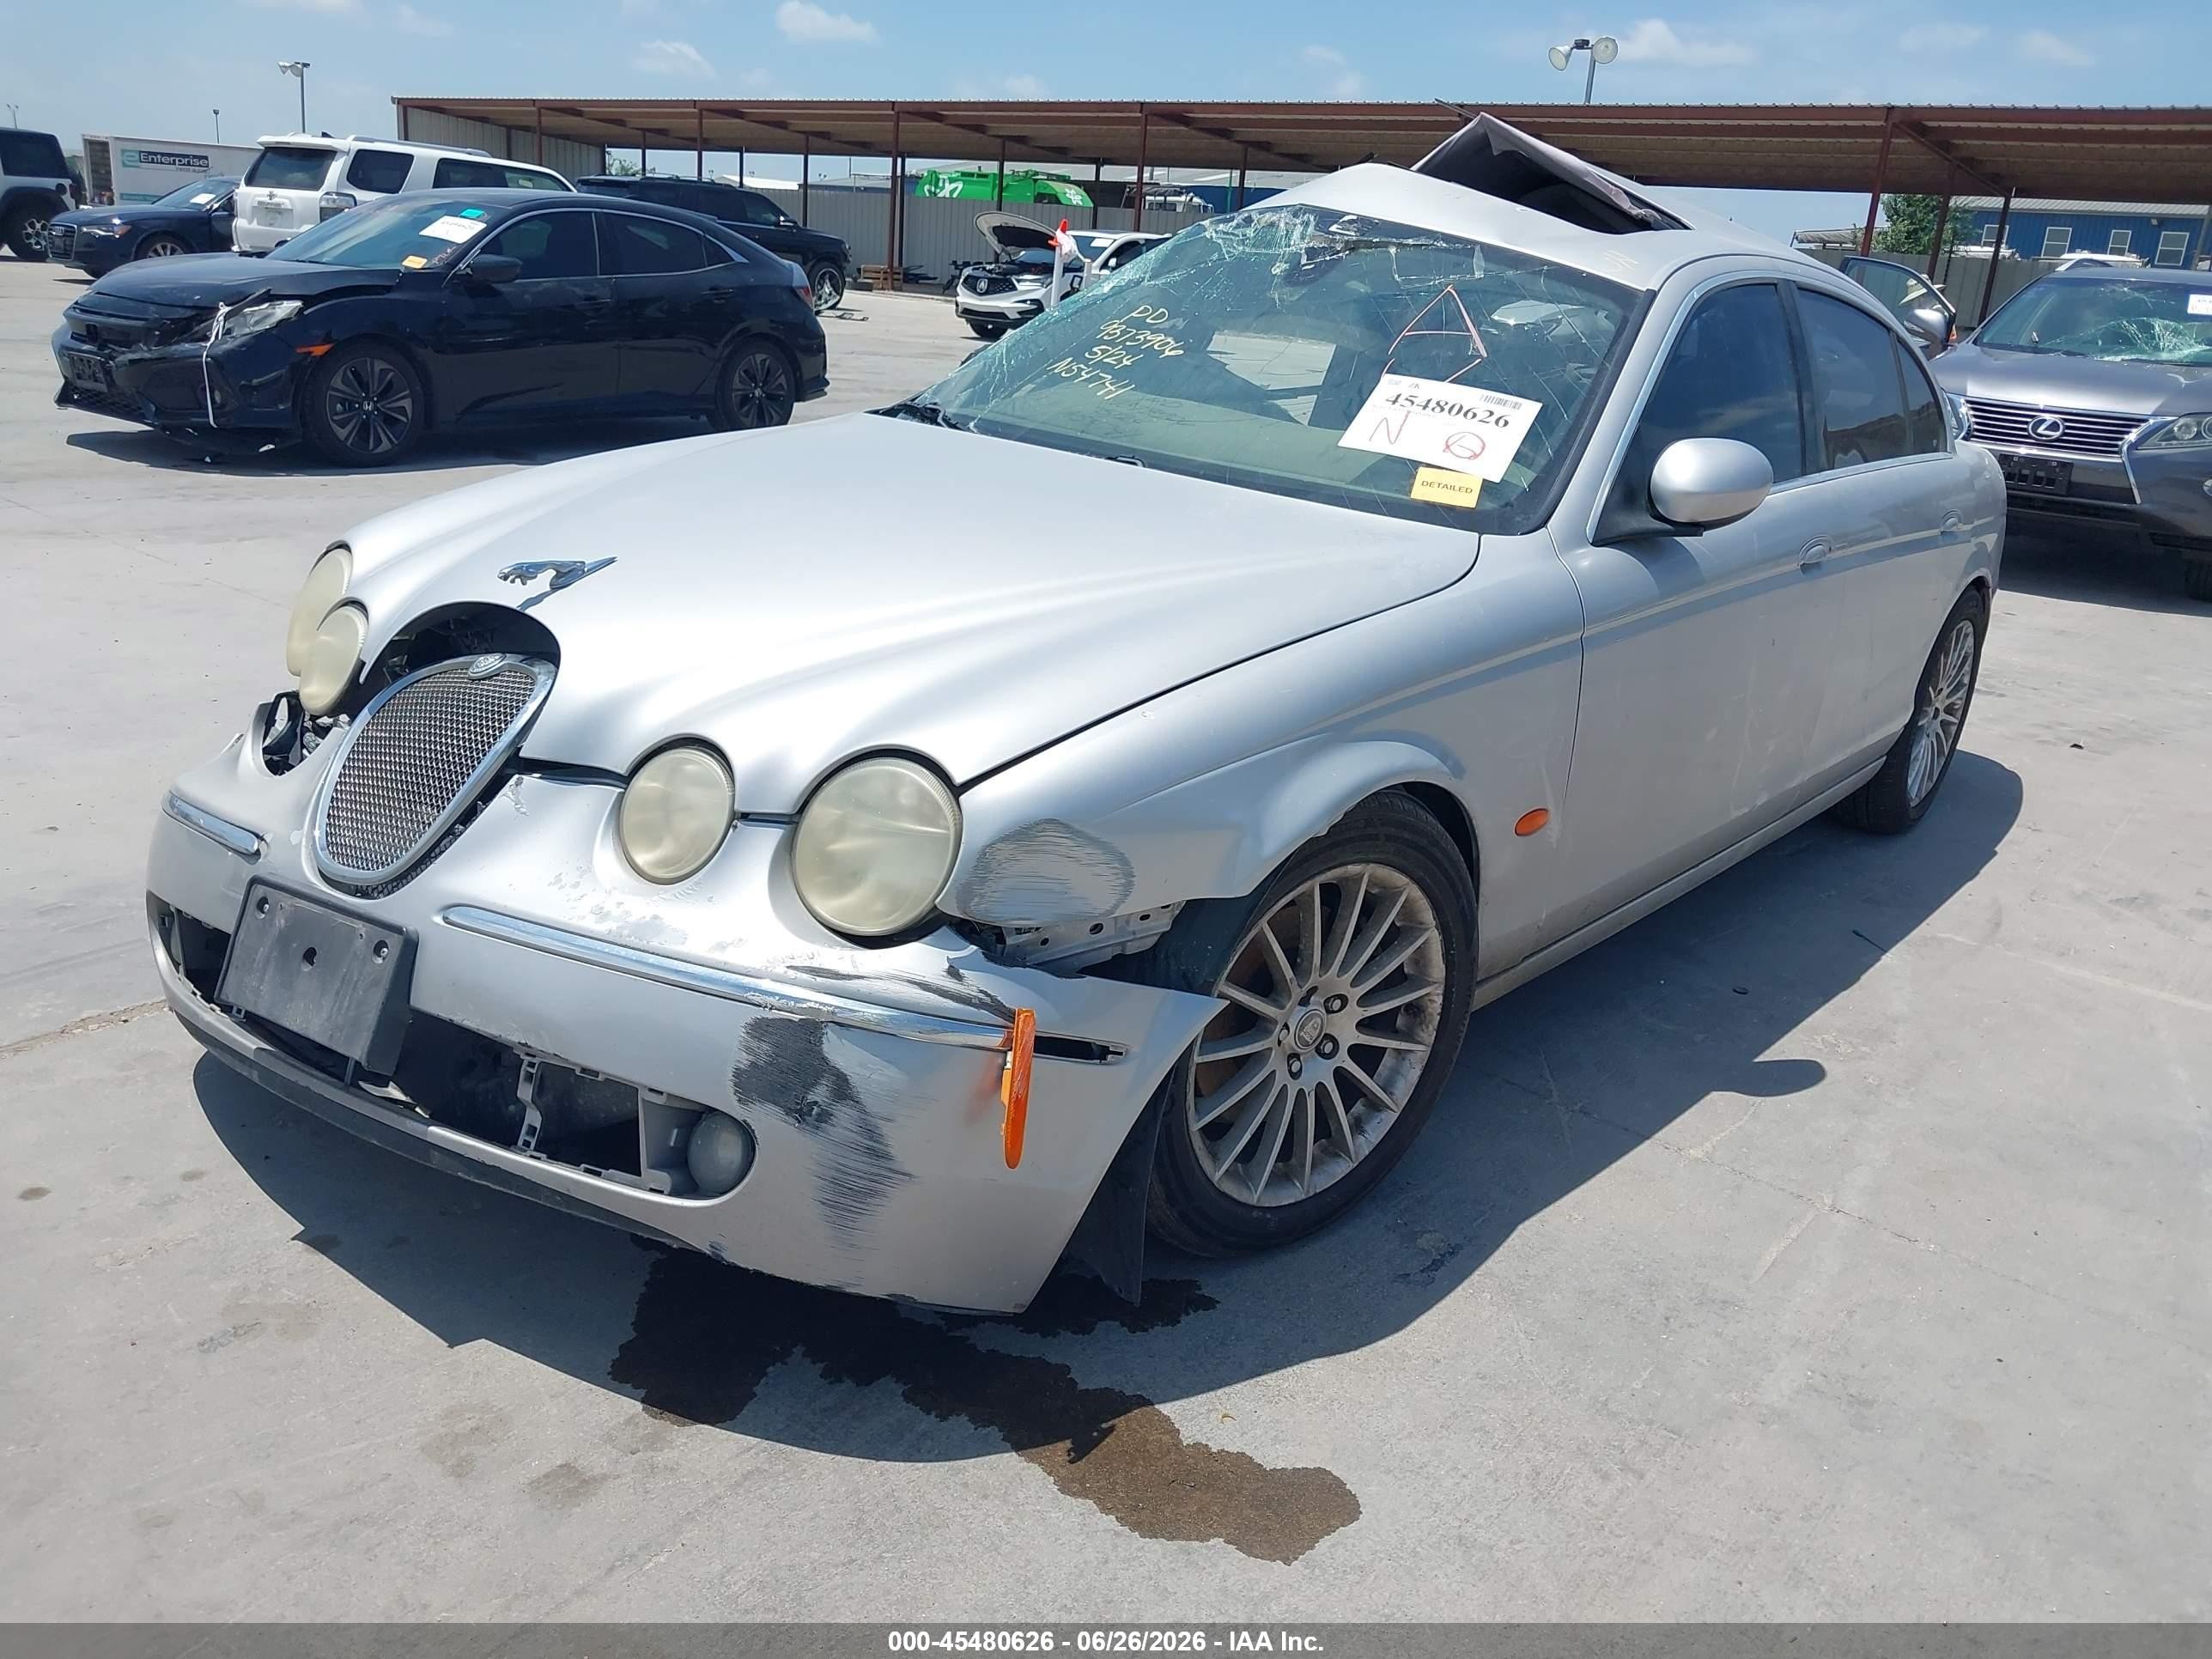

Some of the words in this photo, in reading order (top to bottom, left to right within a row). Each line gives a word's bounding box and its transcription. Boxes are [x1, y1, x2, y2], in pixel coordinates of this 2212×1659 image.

[140, 152, 209, 167] Enterprise
[1121, 305, 1168, 324] PD
[1085, 345, 1144, 369] 5/24
[1046, 357, 1136, 400] N54741
[1384, 392, 1510, 428] 45480626
[1369, 410, 1411, 445] N
[1420, 479, 1474, 495] DETAILED
